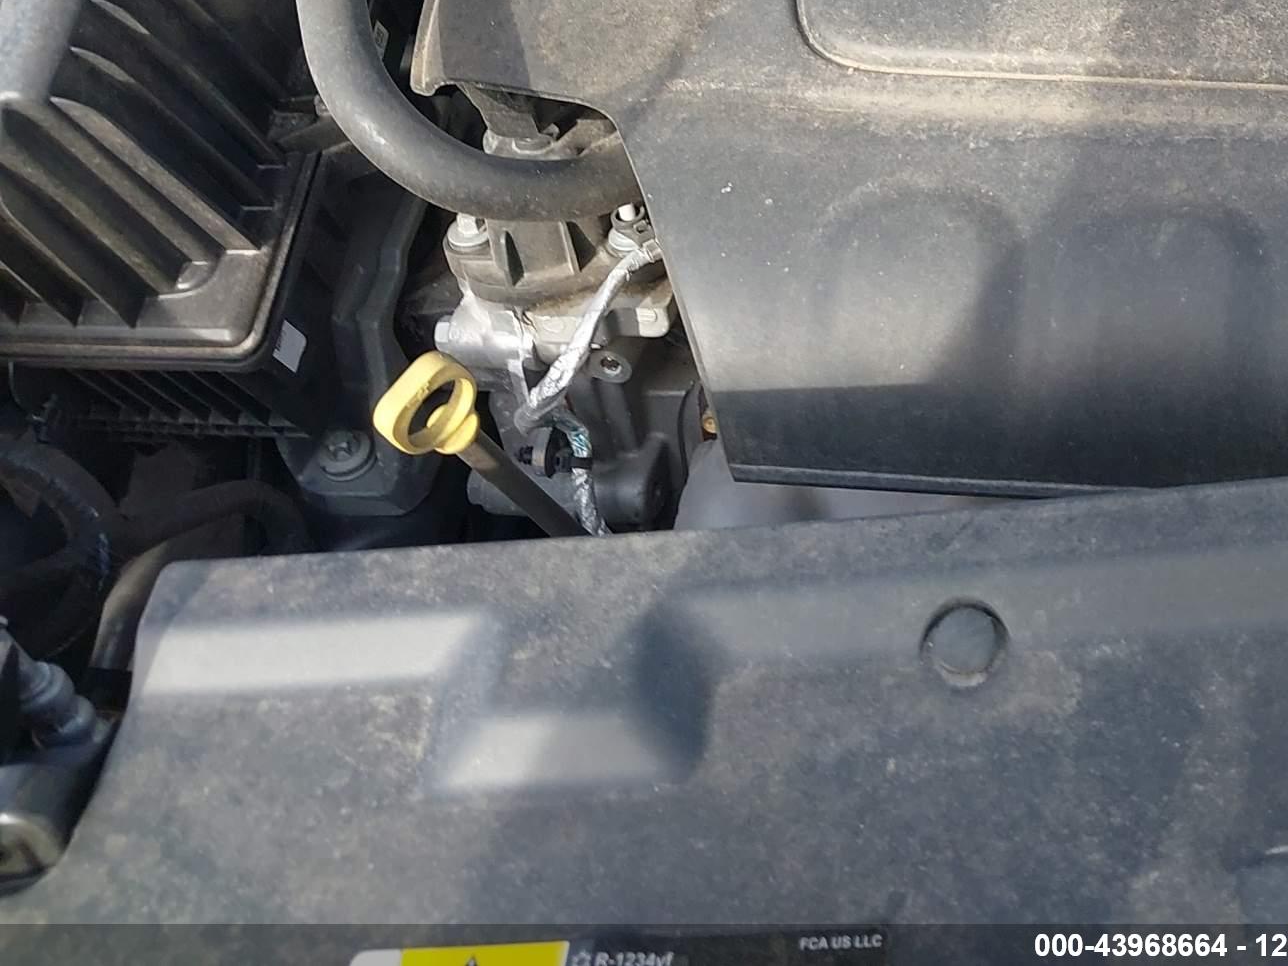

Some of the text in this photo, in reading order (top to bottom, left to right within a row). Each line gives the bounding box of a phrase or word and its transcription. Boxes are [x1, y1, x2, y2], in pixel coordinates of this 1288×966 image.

[800, 934, 884, 950] FCA US LLC
